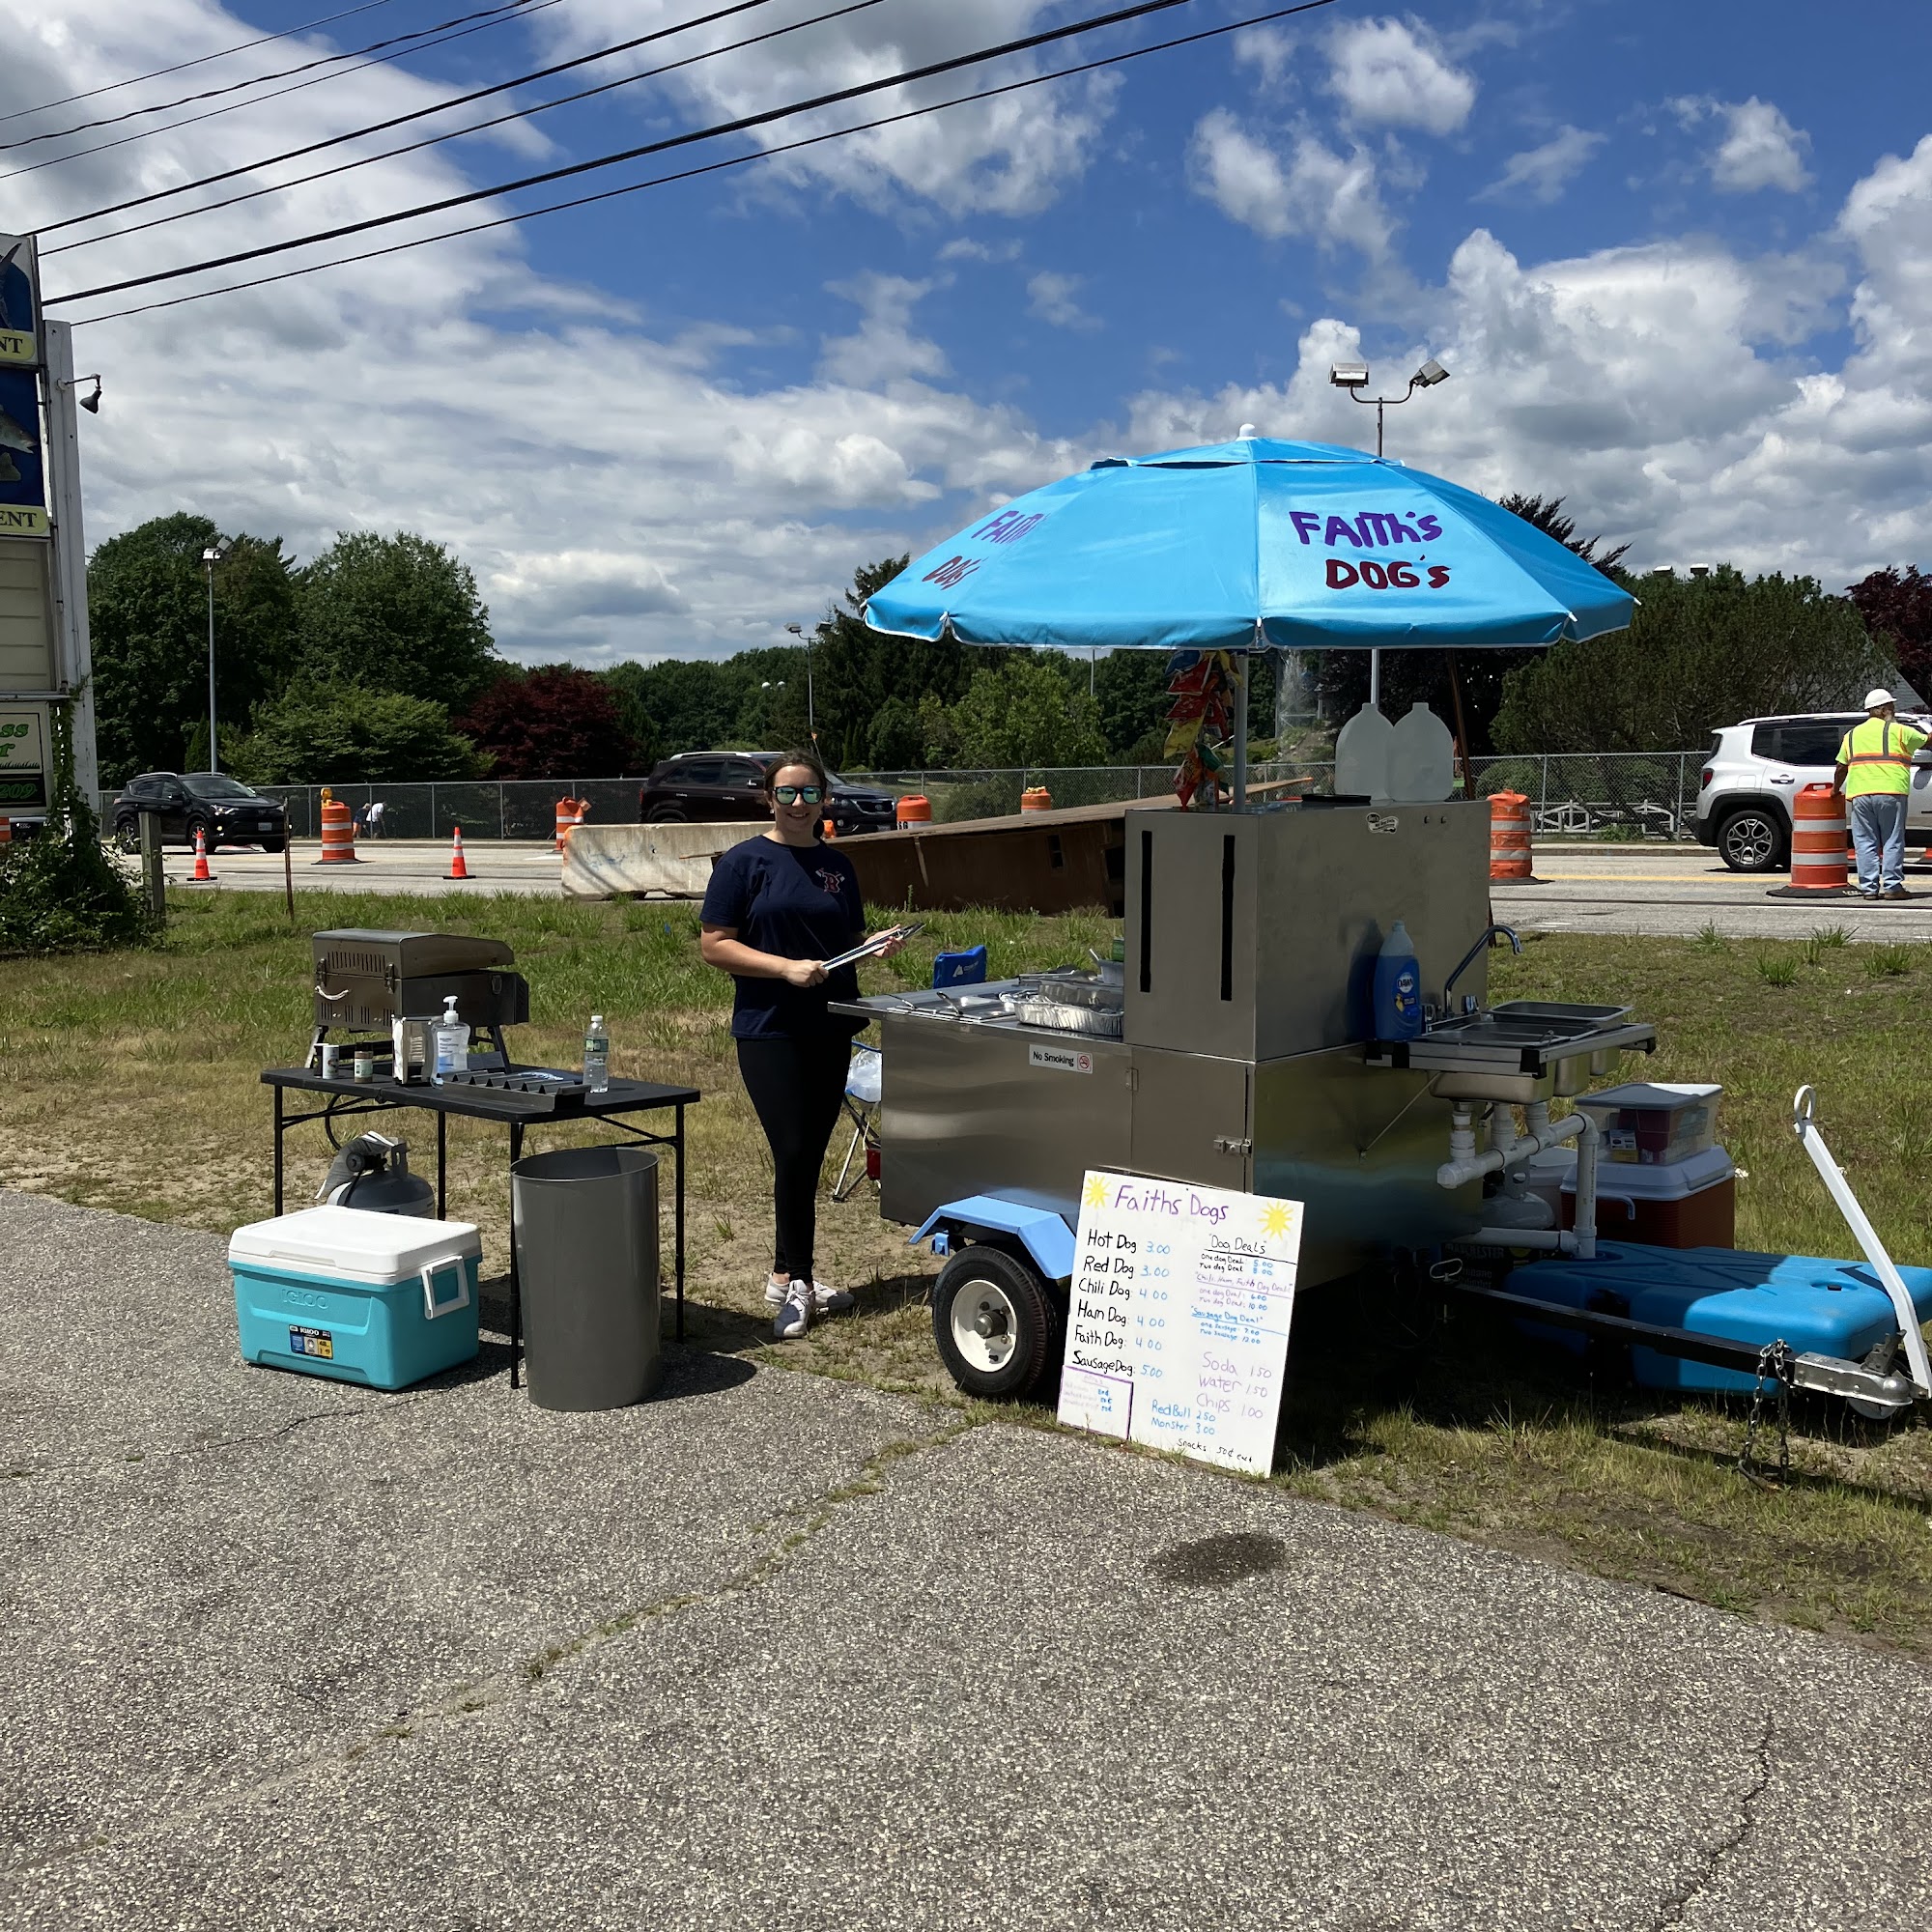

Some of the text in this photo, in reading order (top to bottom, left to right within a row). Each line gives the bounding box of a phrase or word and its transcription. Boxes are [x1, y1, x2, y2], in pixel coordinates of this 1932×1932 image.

[1033, 1050, 1074, 1066] No Smoking
[1114, 1184, 1229, 1225] Faiths Dogs
[1087, 1228, 1113, 1248] Hot
[1116, 1234, 1136, 1254] Dog
[1083, 1256, 1109, 1272] Red
[1078, 1277, 1105, 1294] Chili
[1077, 1299, 1104, 1320] Ham
[1074, 1324, 1102, 1346] Faith
[1202, 1351, 1237, 1376] Soda
[1196, 1392, 1231, 1413] Chips
[1151, 1417, 1189, 1431] Monster
